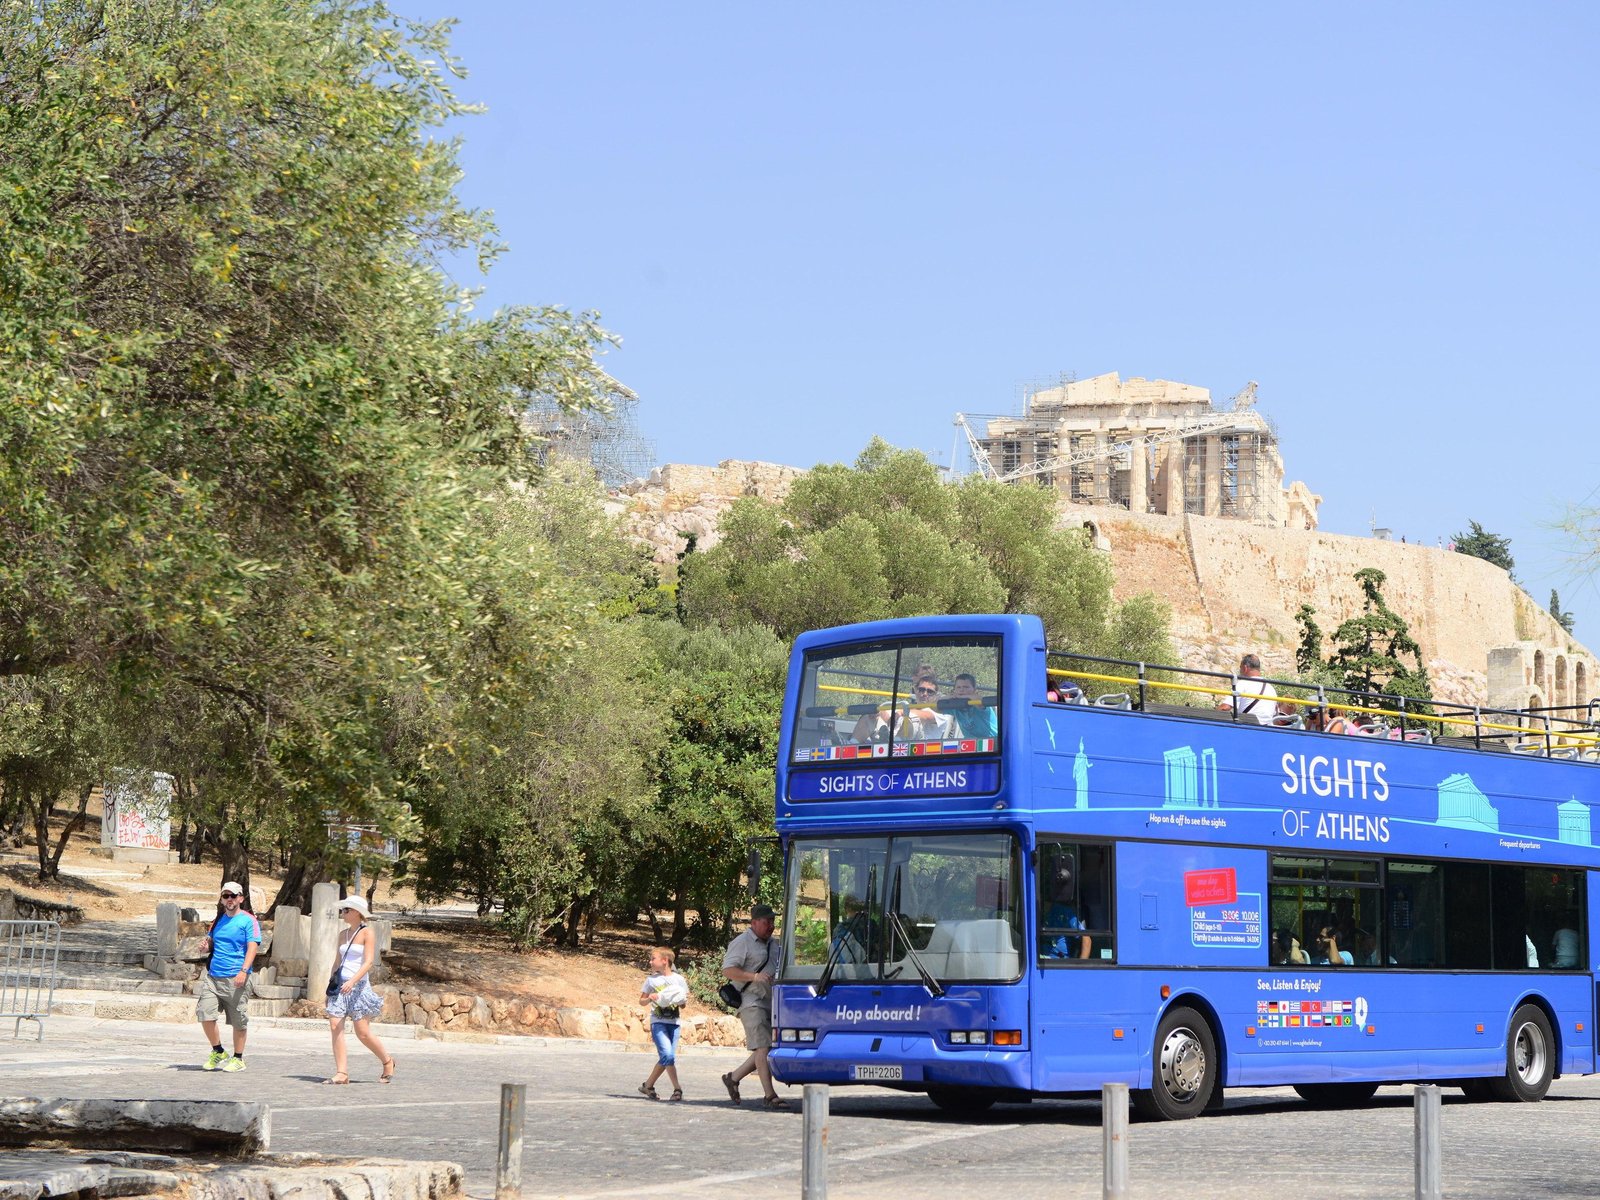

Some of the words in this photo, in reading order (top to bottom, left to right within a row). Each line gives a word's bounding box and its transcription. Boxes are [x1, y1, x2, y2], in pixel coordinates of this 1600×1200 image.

[819, 775, 874, 793] SIGHTS
[878, 773, 900, 791] OF
[903, 770, 967, 790] ATHENS
[1281, 752, 1389, 802] SIGHTS
[1149, 812, 1162, 824] Hop
[1162, 815, 1170, 823] on
[1170, 814, 1175, 823] &
[1175, 814, 1184, 826] off
[1184, 815, 1191, 824] to
[1201, 816, 1210, 826] the
[1210, 818, 1227, 828] sights
[1282, 809, 1311, 837] OF
[1316, 812, 1390, 843] ATHENS
[1499, 838, 1519, 849] Frequent
[1519, 840, 1541, 850] departures
[1257, 979, 1271, 991] See,
[1272, 979, 1293, 990] Listen
[1294, 979, 1300, 990] &
[1300, 978, 1322, 993] Enjoy!
[835, 1004, 862, 1025] Hop
